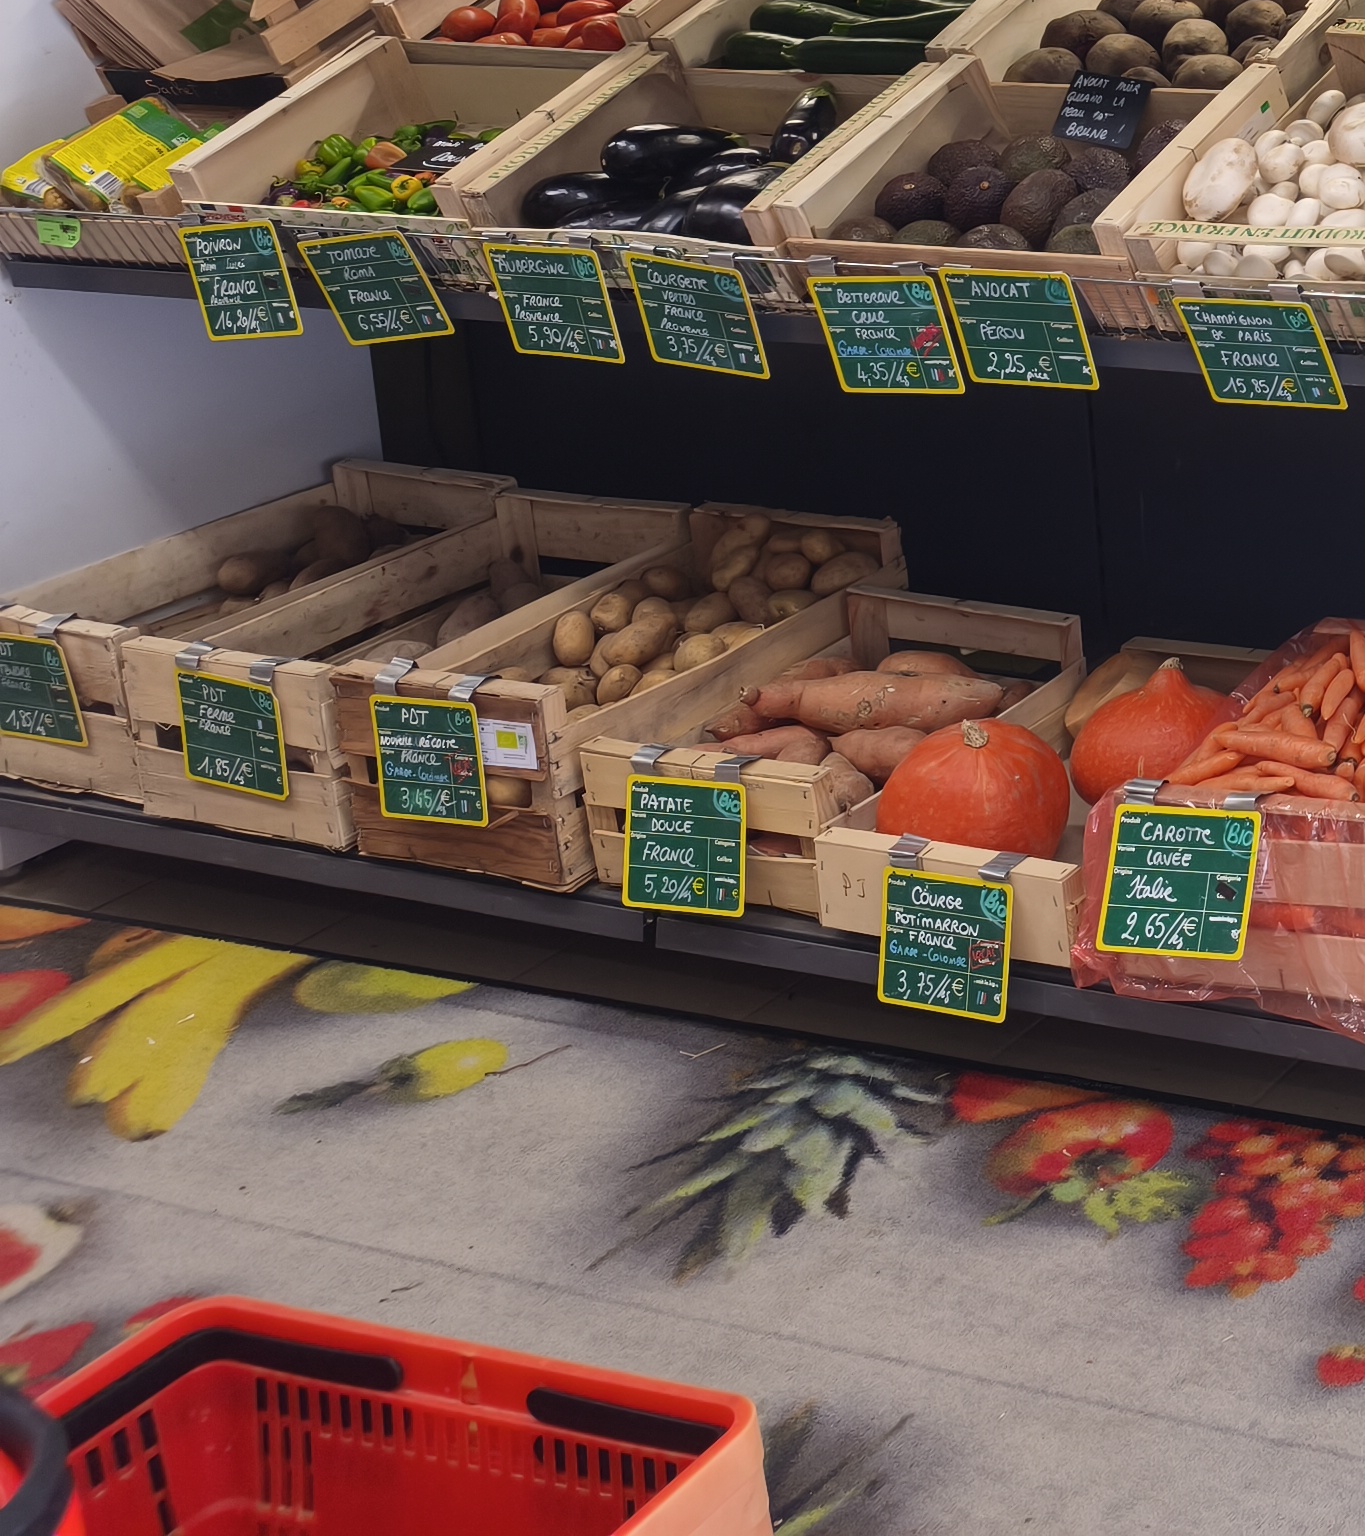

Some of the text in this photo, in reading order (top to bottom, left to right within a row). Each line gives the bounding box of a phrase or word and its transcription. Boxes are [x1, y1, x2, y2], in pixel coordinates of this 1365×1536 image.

[970, 280, 1032, 299] AVOCAT
[1194, 310, 1274, 326] CHAMPIGNON
[1237, 329, 1273, 343] PARIS
[400, 707, 430, 726] PDT
[639, 792, 695, 813] PATATE
[651, 817, 695, 835] DOUCE
